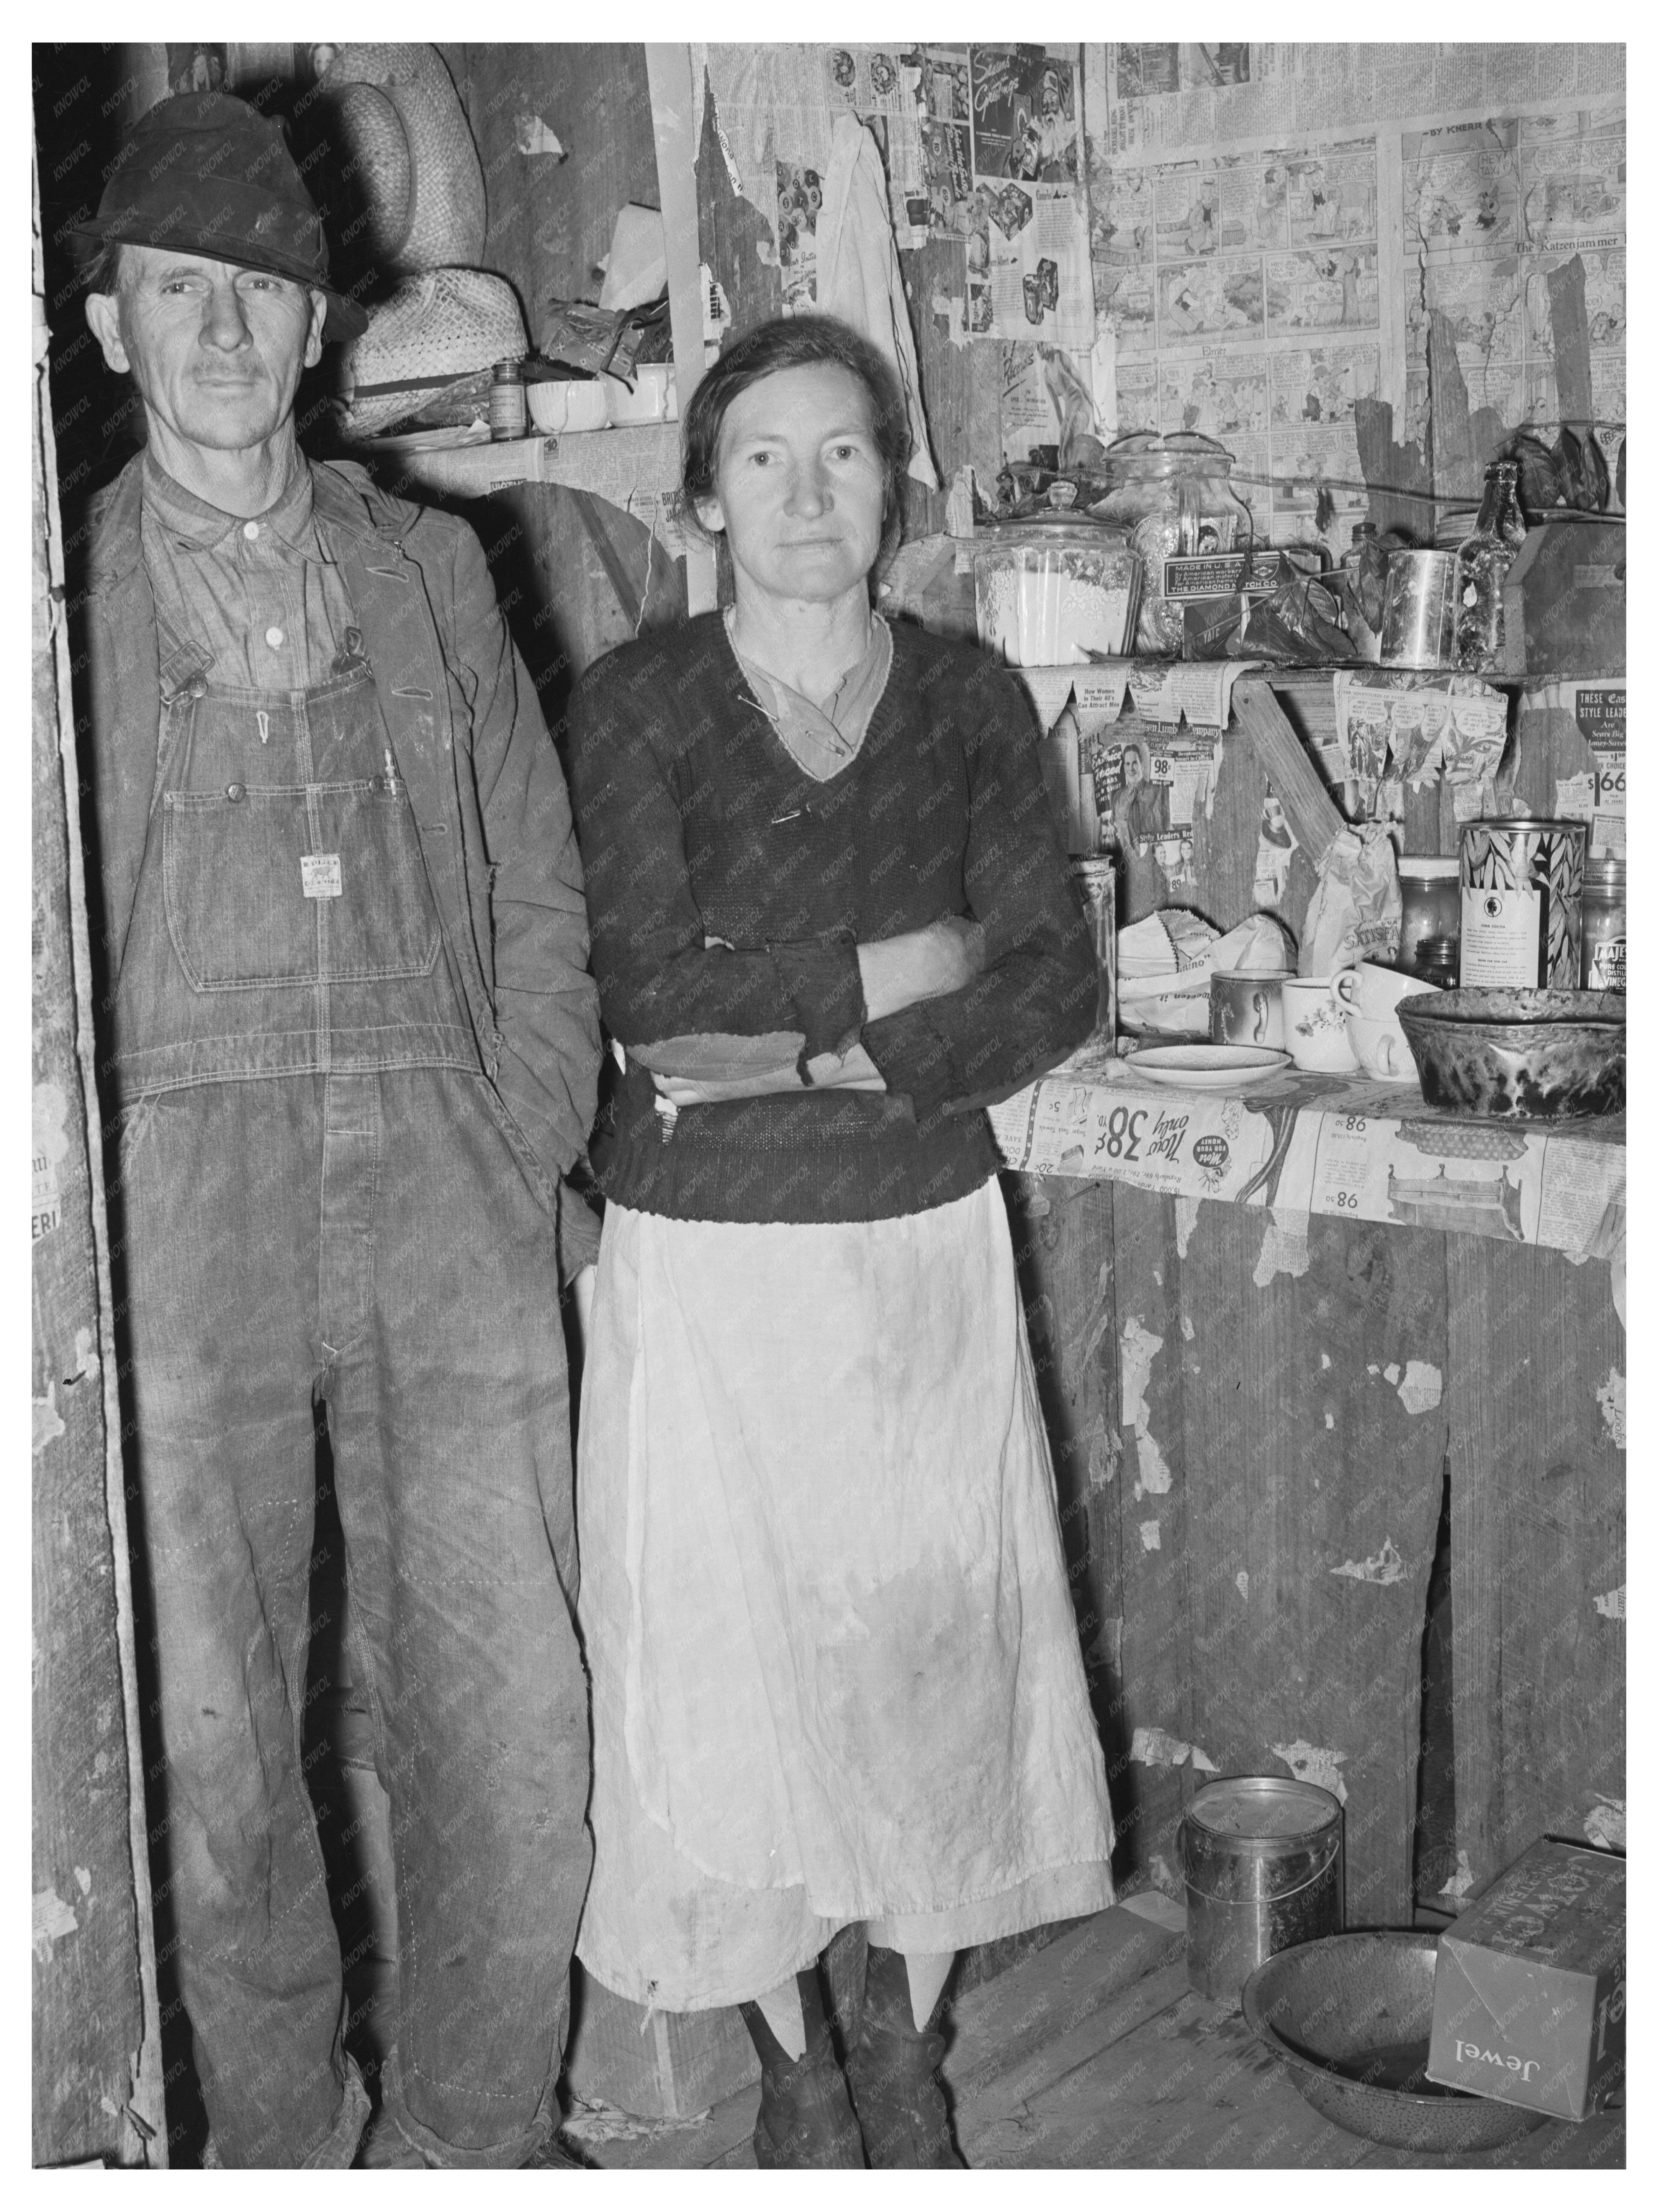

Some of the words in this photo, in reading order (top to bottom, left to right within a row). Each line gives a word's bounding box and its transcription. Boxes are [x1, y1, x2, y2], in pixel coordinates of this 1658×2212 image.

[1447, 121, 1482, 134] KNERR
[1481, 153, 1503, 164] HEY
[1036, 189, 1052, 200] Camels
[1514, 242, 1534, 253] The
[1202, 346, 1227, 356] Elmer
[1580, 693, 1603, 704] THESE
[1580, 707, 1601, 718] STYLE
[1188, 723, 1223, 738] Company
[1600, 721, 1615, 729] Are
[1612, 730, 1624, 739] Big
[1607, 762, 1626, 770] CHOICE
[1157, 832, 1180, 841] Leaders
[1039, 1125, 1056, 1134] Towels
[1152, 1110, 1189, 1140] only
[1074, 1128, 1087, 1137] Sugar
[1347, 1133, 1367, 1142] Regularly
[1146, 1129, 1187, 1164] Now
[1198, 1152, 1222, 1165] More
[1092, 1164, 1106, 1173] Yard
[1157, 1172, 1182, 1183] Regularly
[1613, 1407, 1623, 1445] Looks
[1455, 2038, 1541, 2083] Jewel
